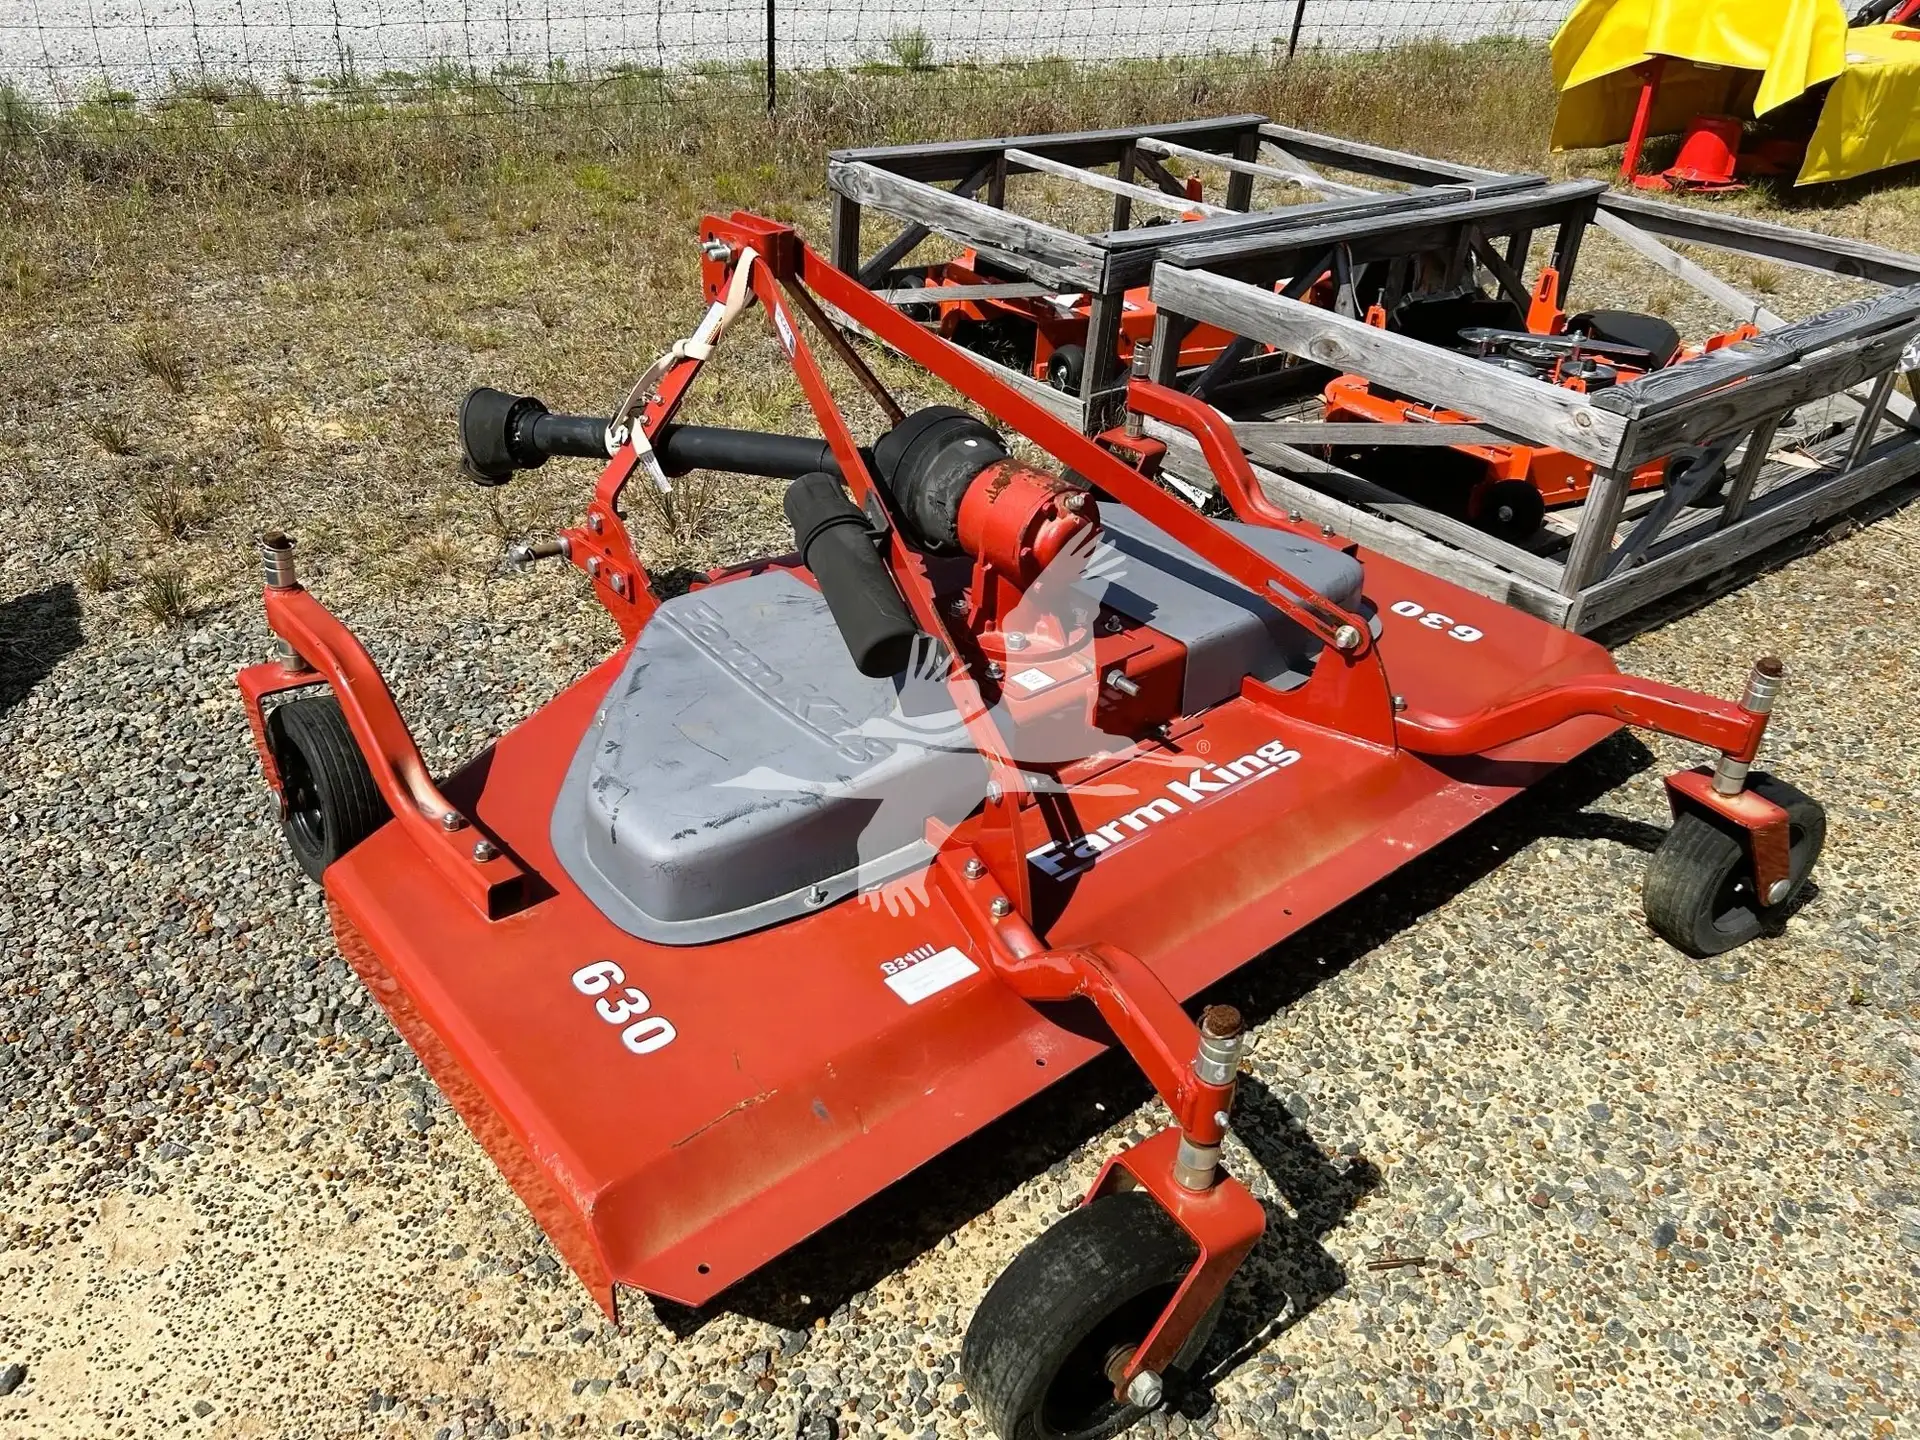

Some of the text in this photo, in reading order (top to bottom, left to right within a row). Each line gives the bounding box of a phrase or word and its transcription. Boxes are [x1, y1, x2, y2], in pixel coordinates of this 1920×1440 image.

[1390, 600, 1484, 642] 630
[1026, 739, 1302, 875] Farm King
[571, 960, 677, 1055] 630
